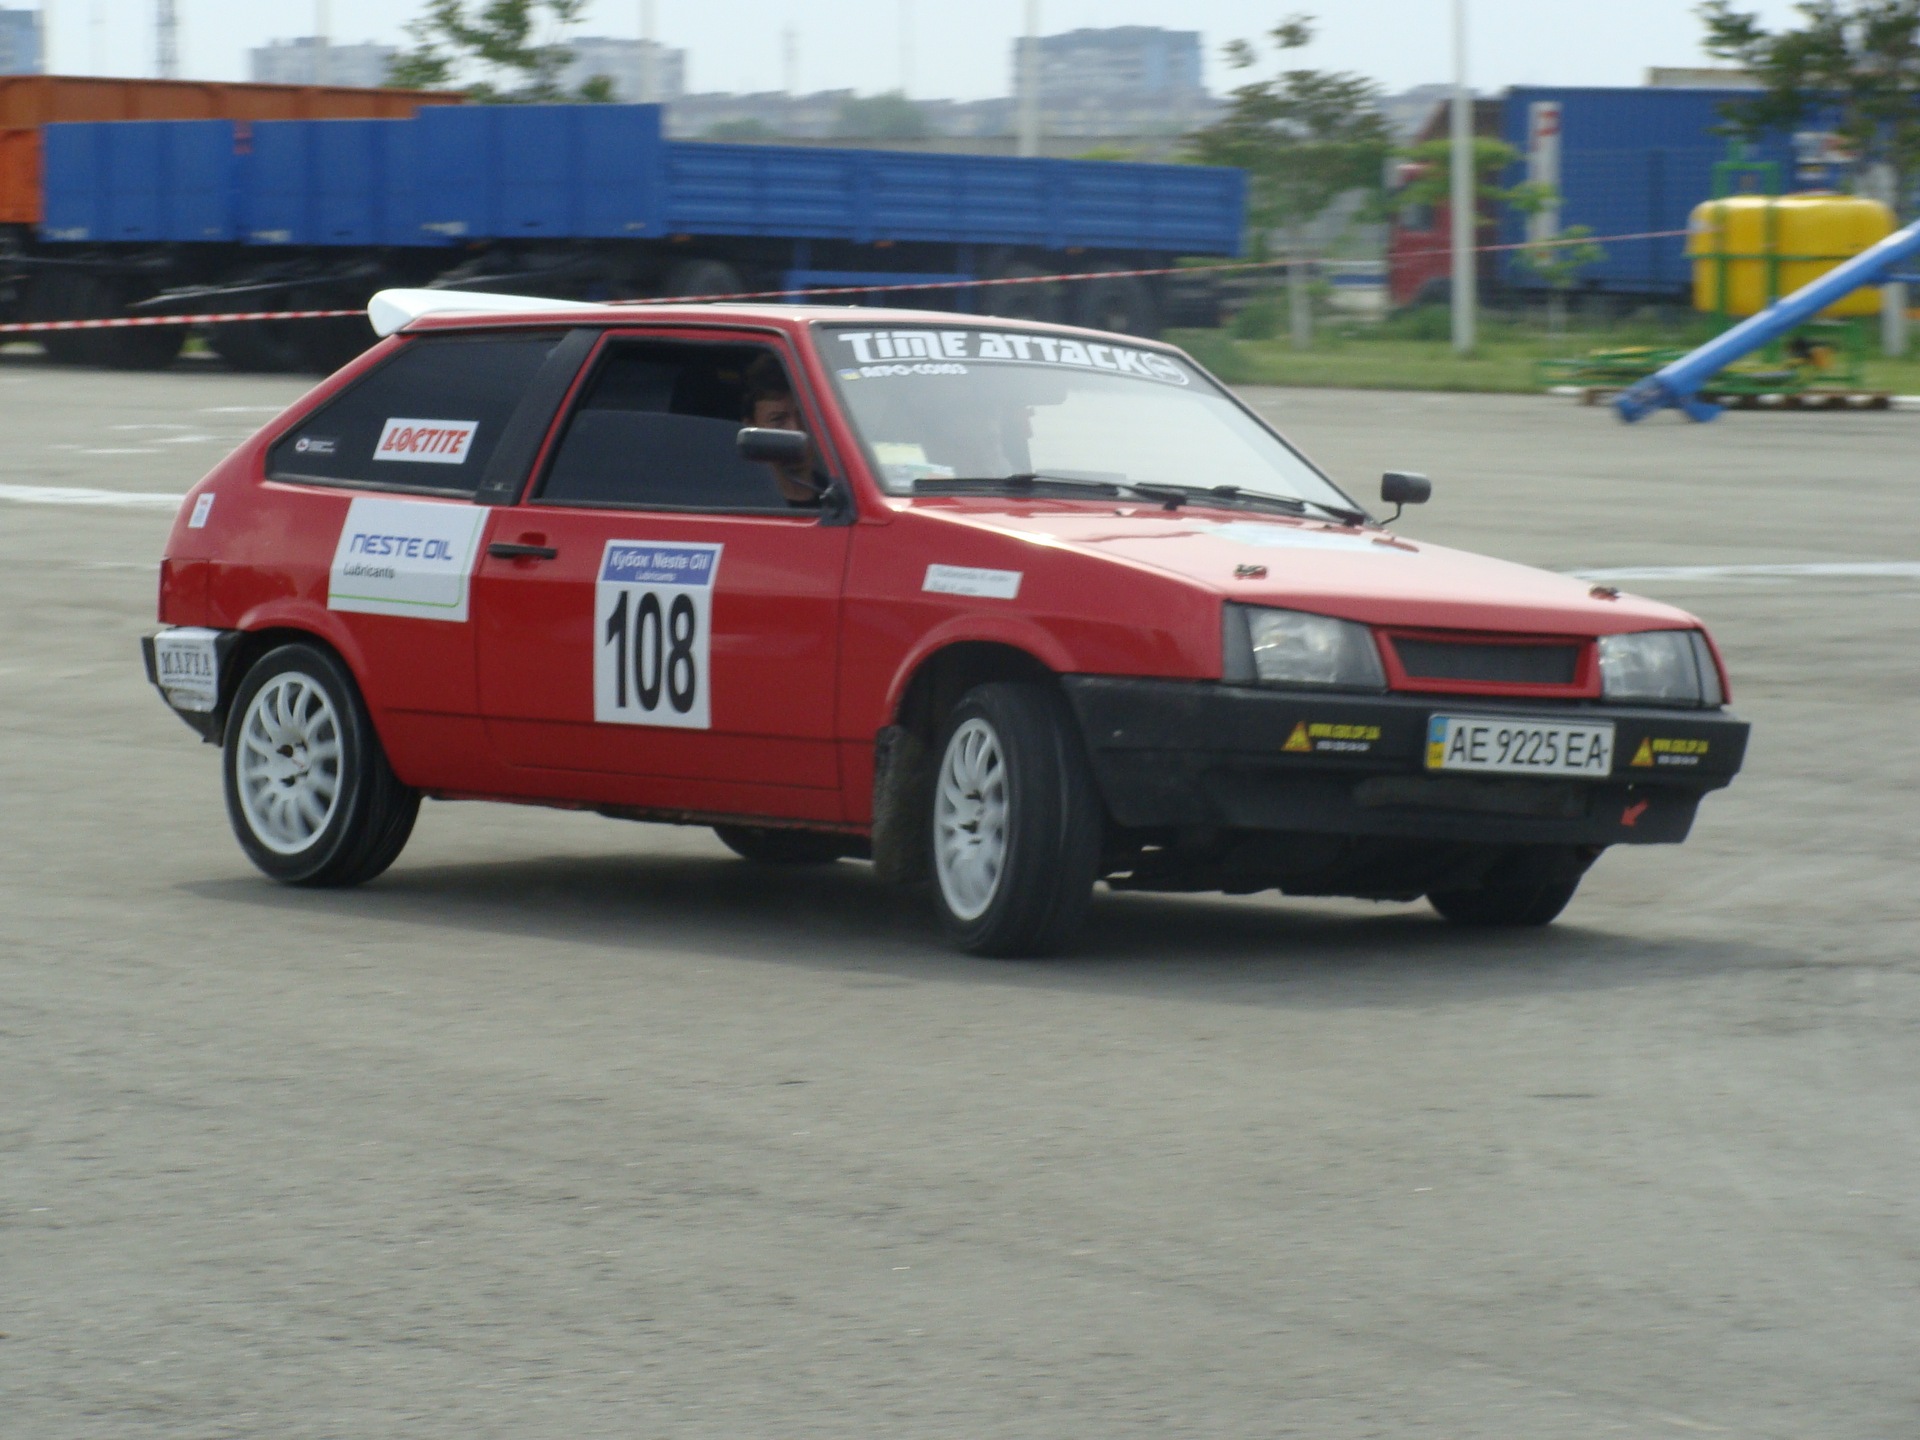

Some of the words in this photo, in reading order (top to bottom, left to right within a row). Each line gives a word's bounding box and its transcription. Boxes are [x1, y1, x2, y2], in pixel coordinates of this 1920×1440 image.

[382, 426, 469, 453] LOCTITE
[423, 539, 453, 561] OIL
[651, 552, 689, 569] Neste
[343, 562, 395, 579] Lubricants
[605, 590, 696, 714] 108
[1448, 726, 1490, 763] AE
[1496, 728, 1560, 765] 9225
[1565, 732, 1603, 768] EA
